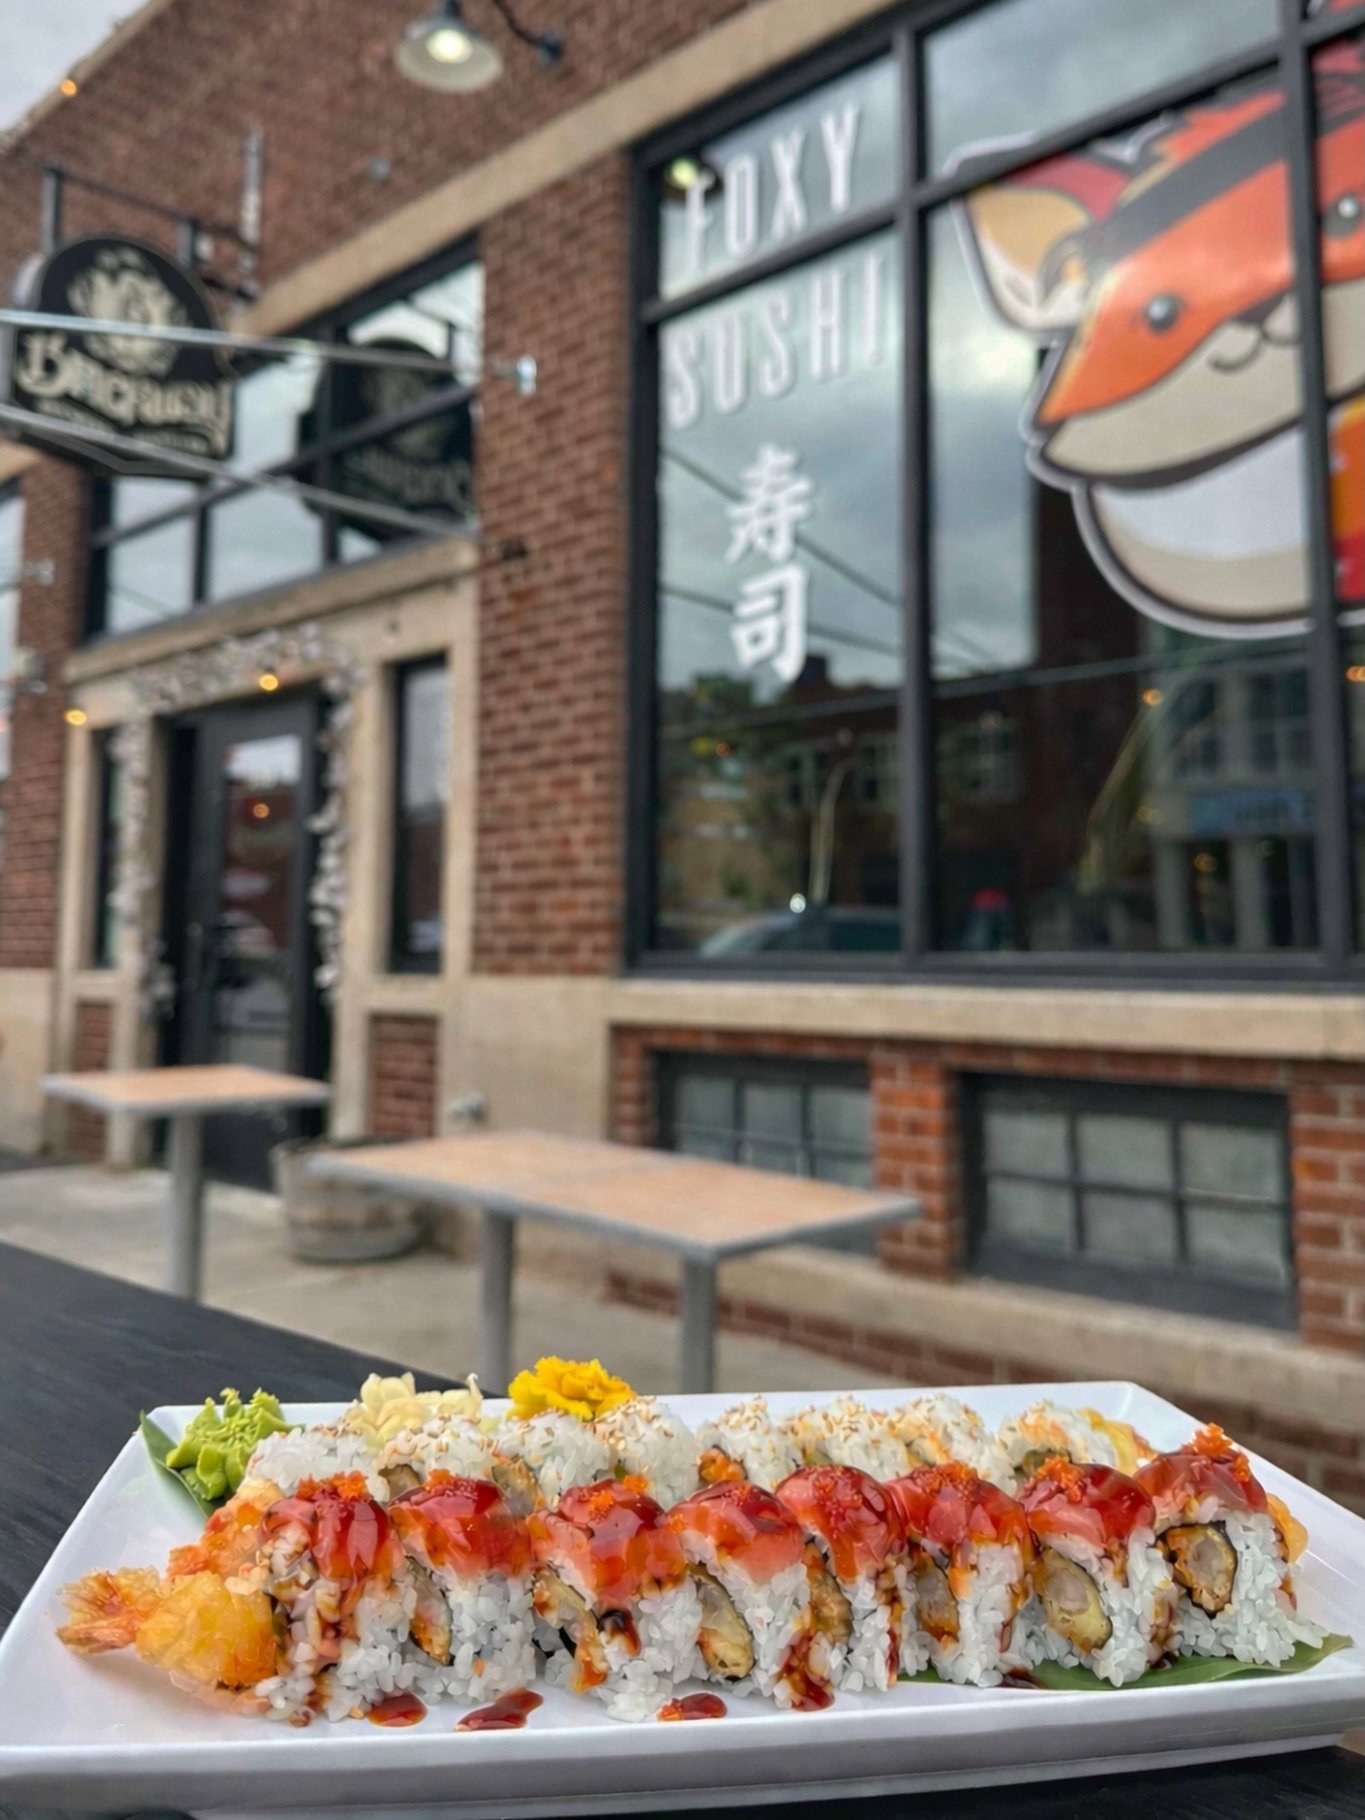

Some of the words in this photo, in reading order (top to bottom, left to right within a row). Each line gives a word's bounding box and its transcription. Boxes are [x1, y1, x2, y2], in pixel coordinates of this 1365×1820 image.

[684, 104, 862, 272] FOXY
[667, 254, 882, 428] SUSHI
[725, 443, 811, 683] 寿司
